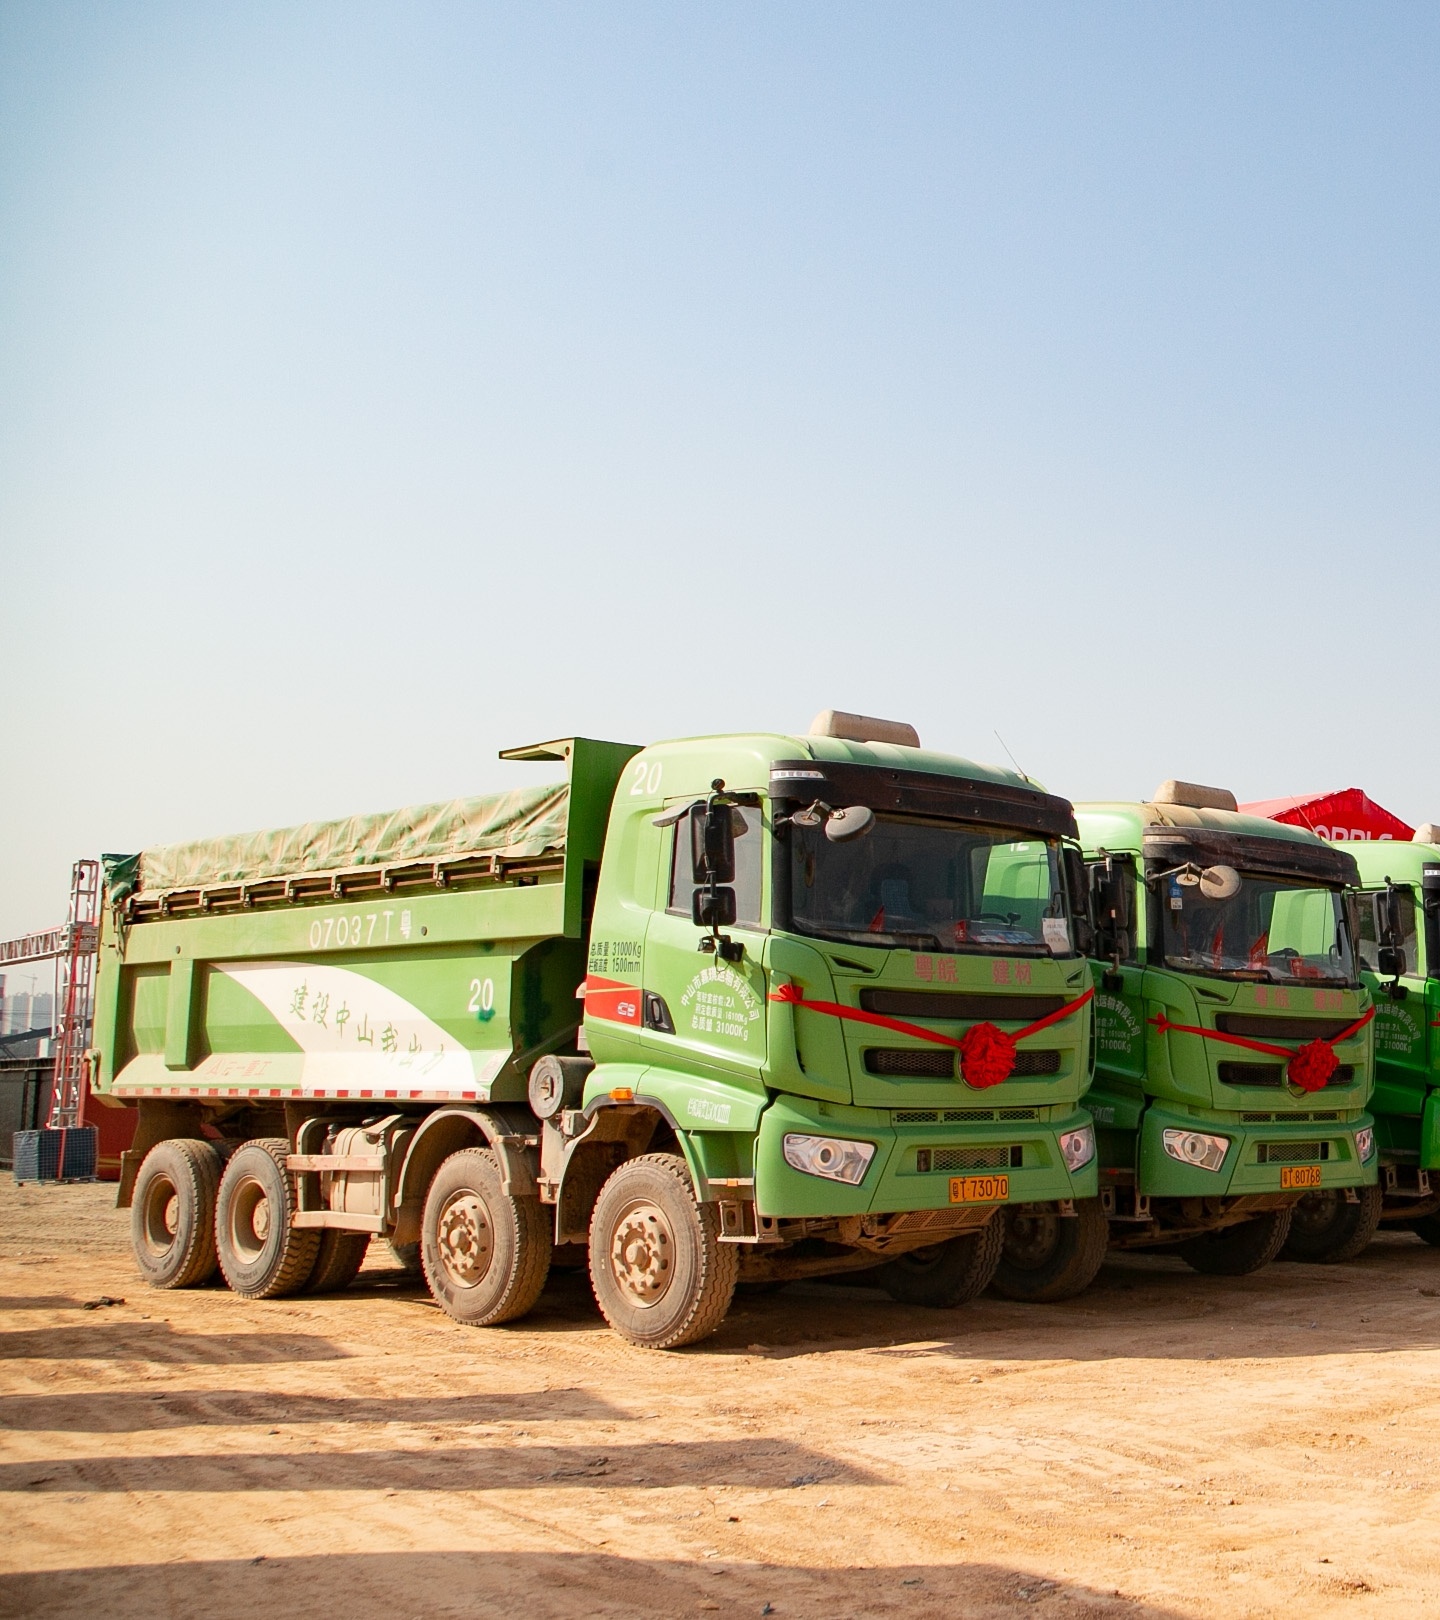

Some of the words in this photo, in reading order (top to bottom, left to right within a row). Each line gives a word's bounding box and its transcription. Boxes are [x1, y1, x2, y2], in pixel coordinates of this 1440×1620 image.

[630, 761, 662, 796] 20
[612, 941, 642, 958] 31000Kg
[612, 957, 640, 973] 1500mm
[468, 978, 494, 1012] 20
[716, 1021, 749, 1041] 31000Kg
